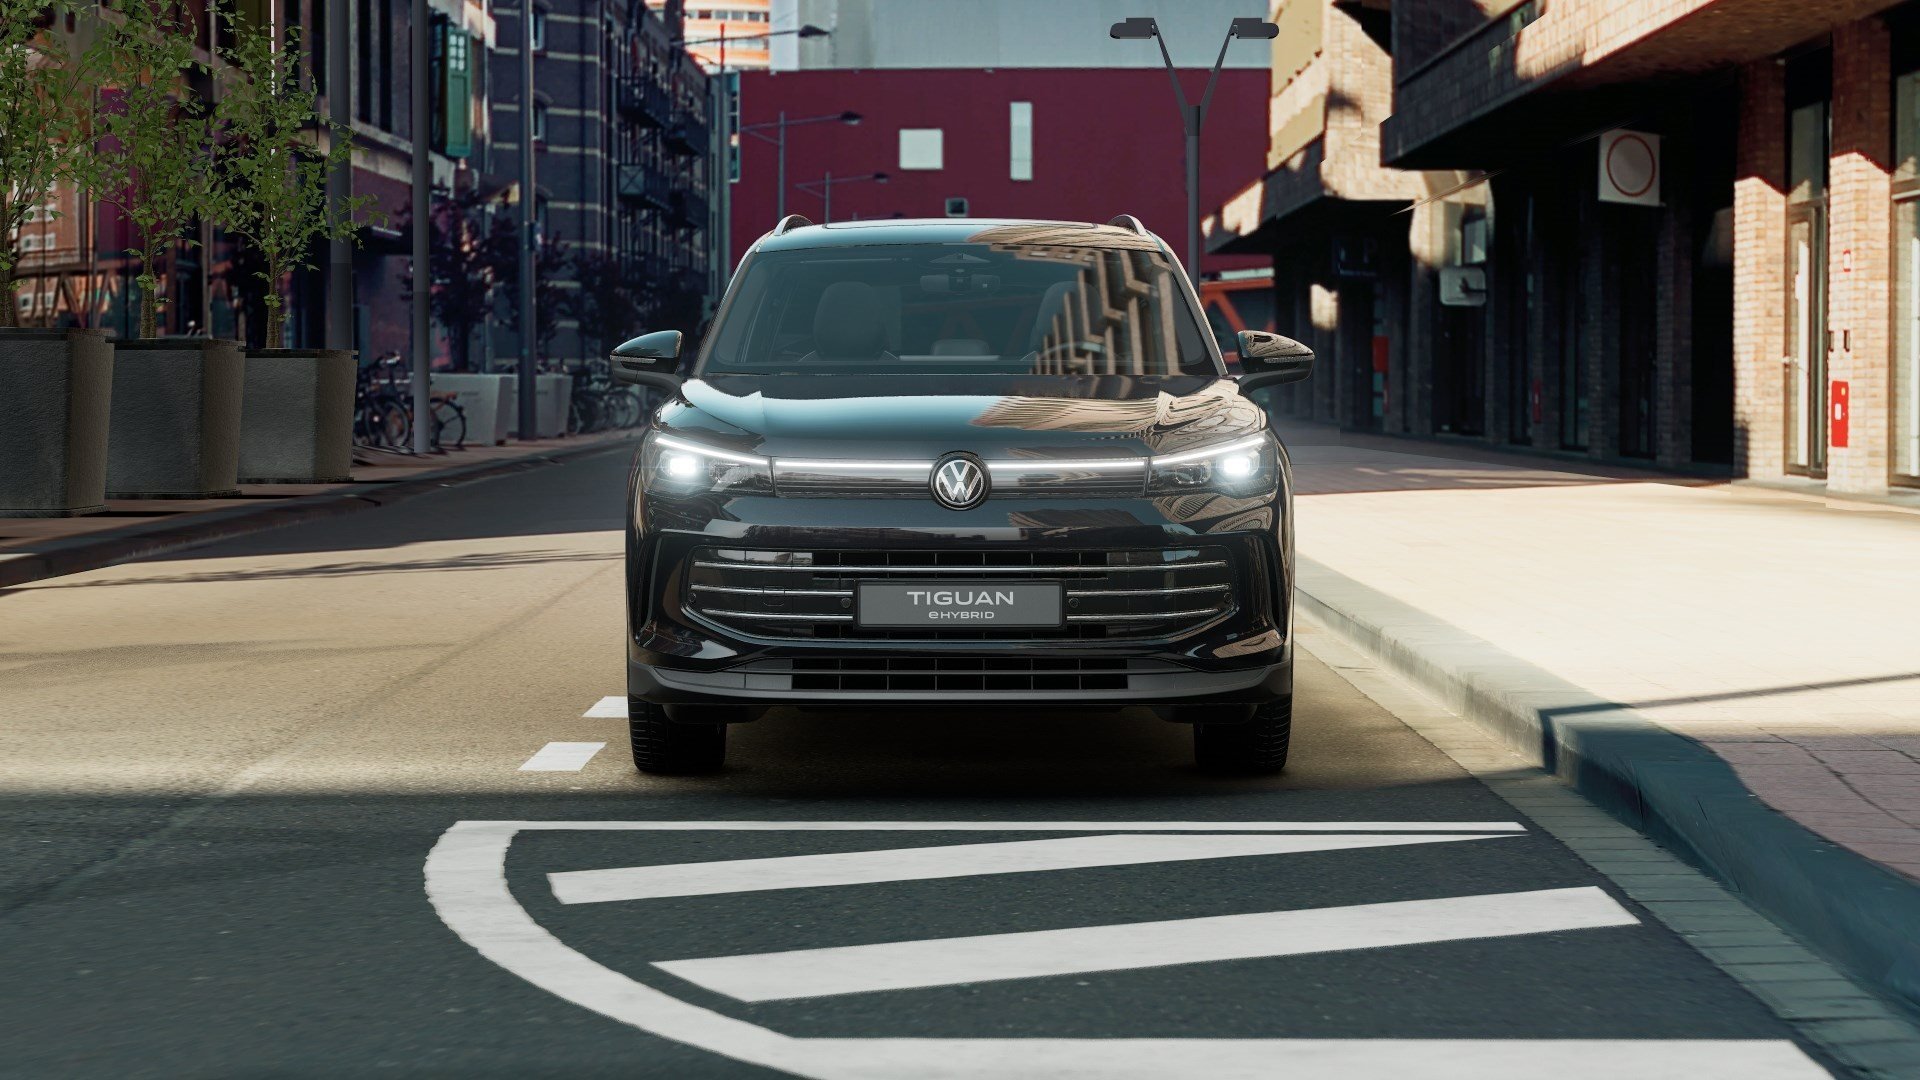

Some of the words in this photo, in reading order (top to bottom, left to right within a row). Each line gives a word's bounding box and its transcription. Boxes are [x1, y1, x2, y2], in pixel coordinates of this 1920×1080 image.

[936, 458, 983, 504] VW
[906, 591, 1014, 606] TIGUAN
[928, 611, 995, 619] eHYBRID
